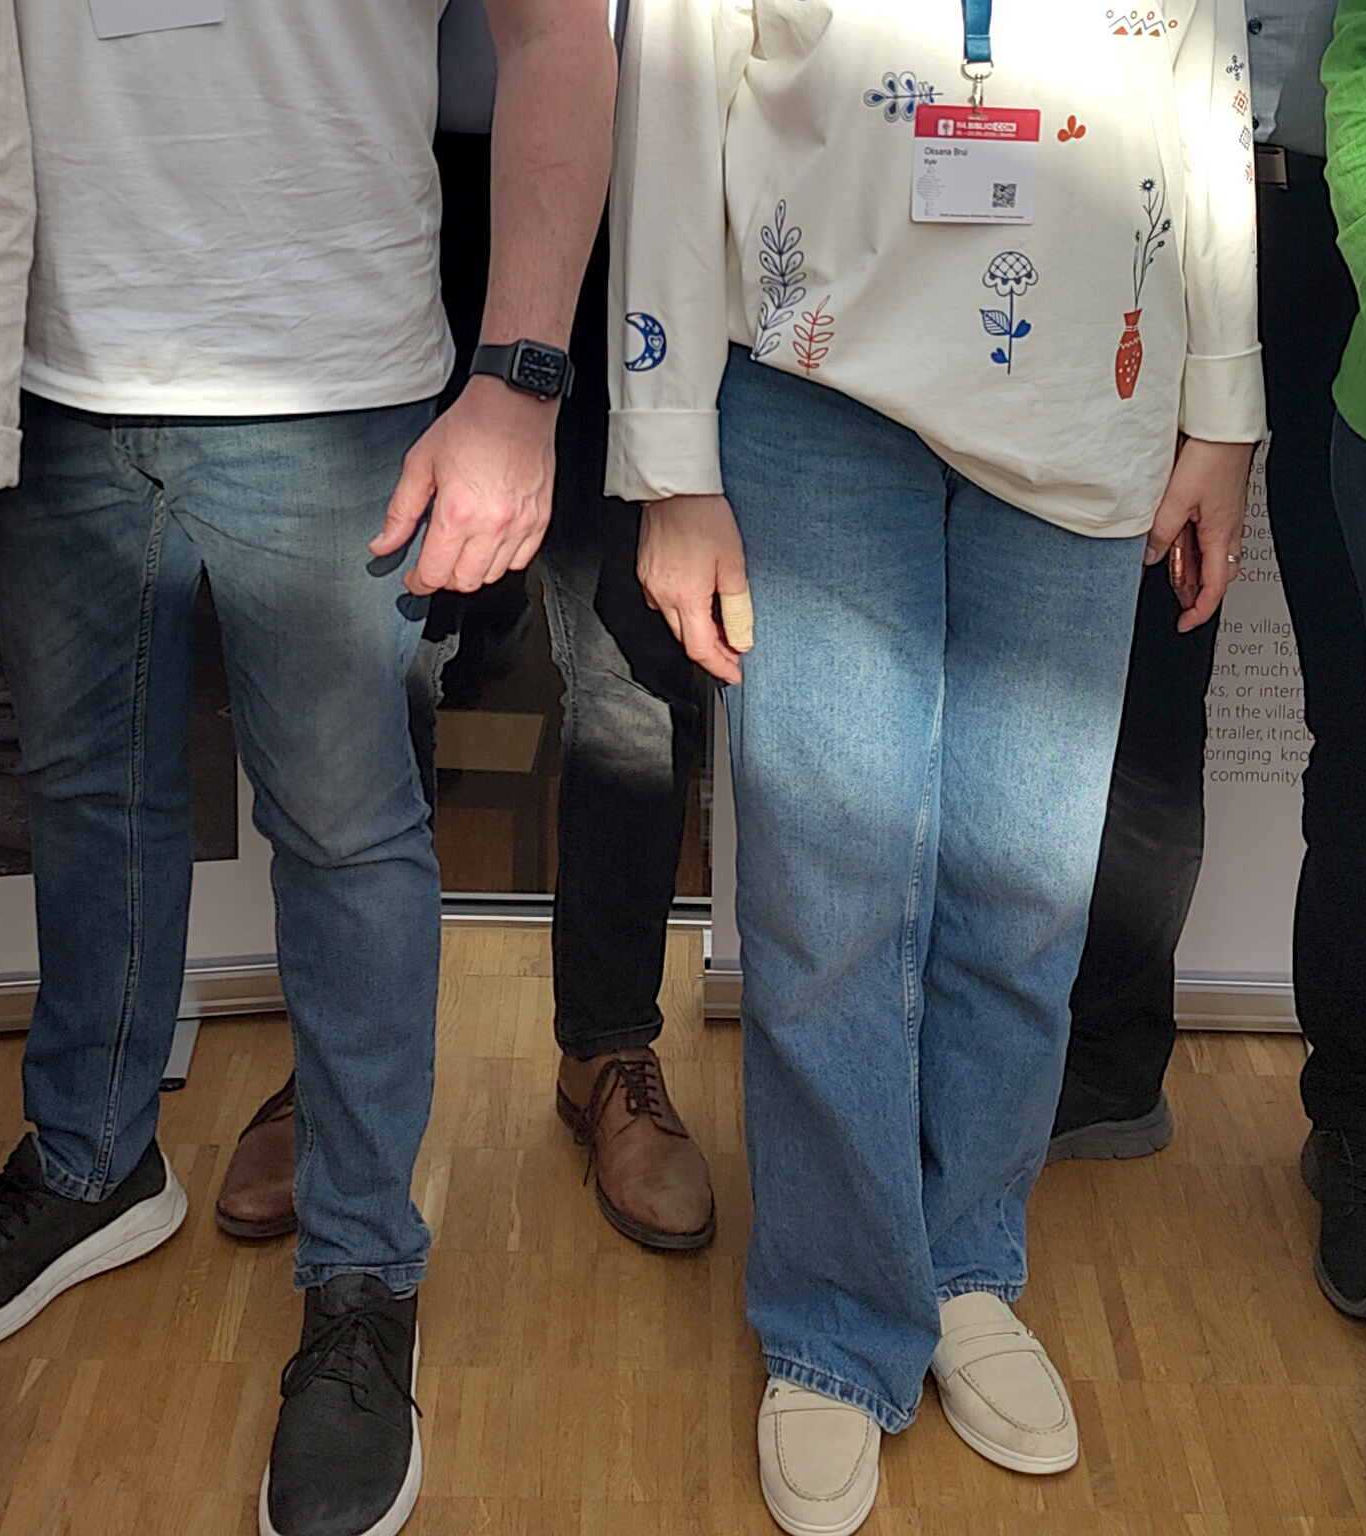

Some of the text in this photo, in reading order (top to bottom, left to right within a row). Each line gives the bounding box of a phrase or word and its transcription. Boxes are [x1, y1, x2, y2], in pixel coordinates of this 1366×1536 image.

[1228, 642, 1263, 655] over
[1245, 663, 1289, 677] much
[1236, 685, 1253, 698] or
[1217, 705, 1261, 719] in the
[1216, 726, 1277, 742] trailer, it
[1206, 747, 1271, 764] bringing
[1210, 769, 1301, 786] community.
